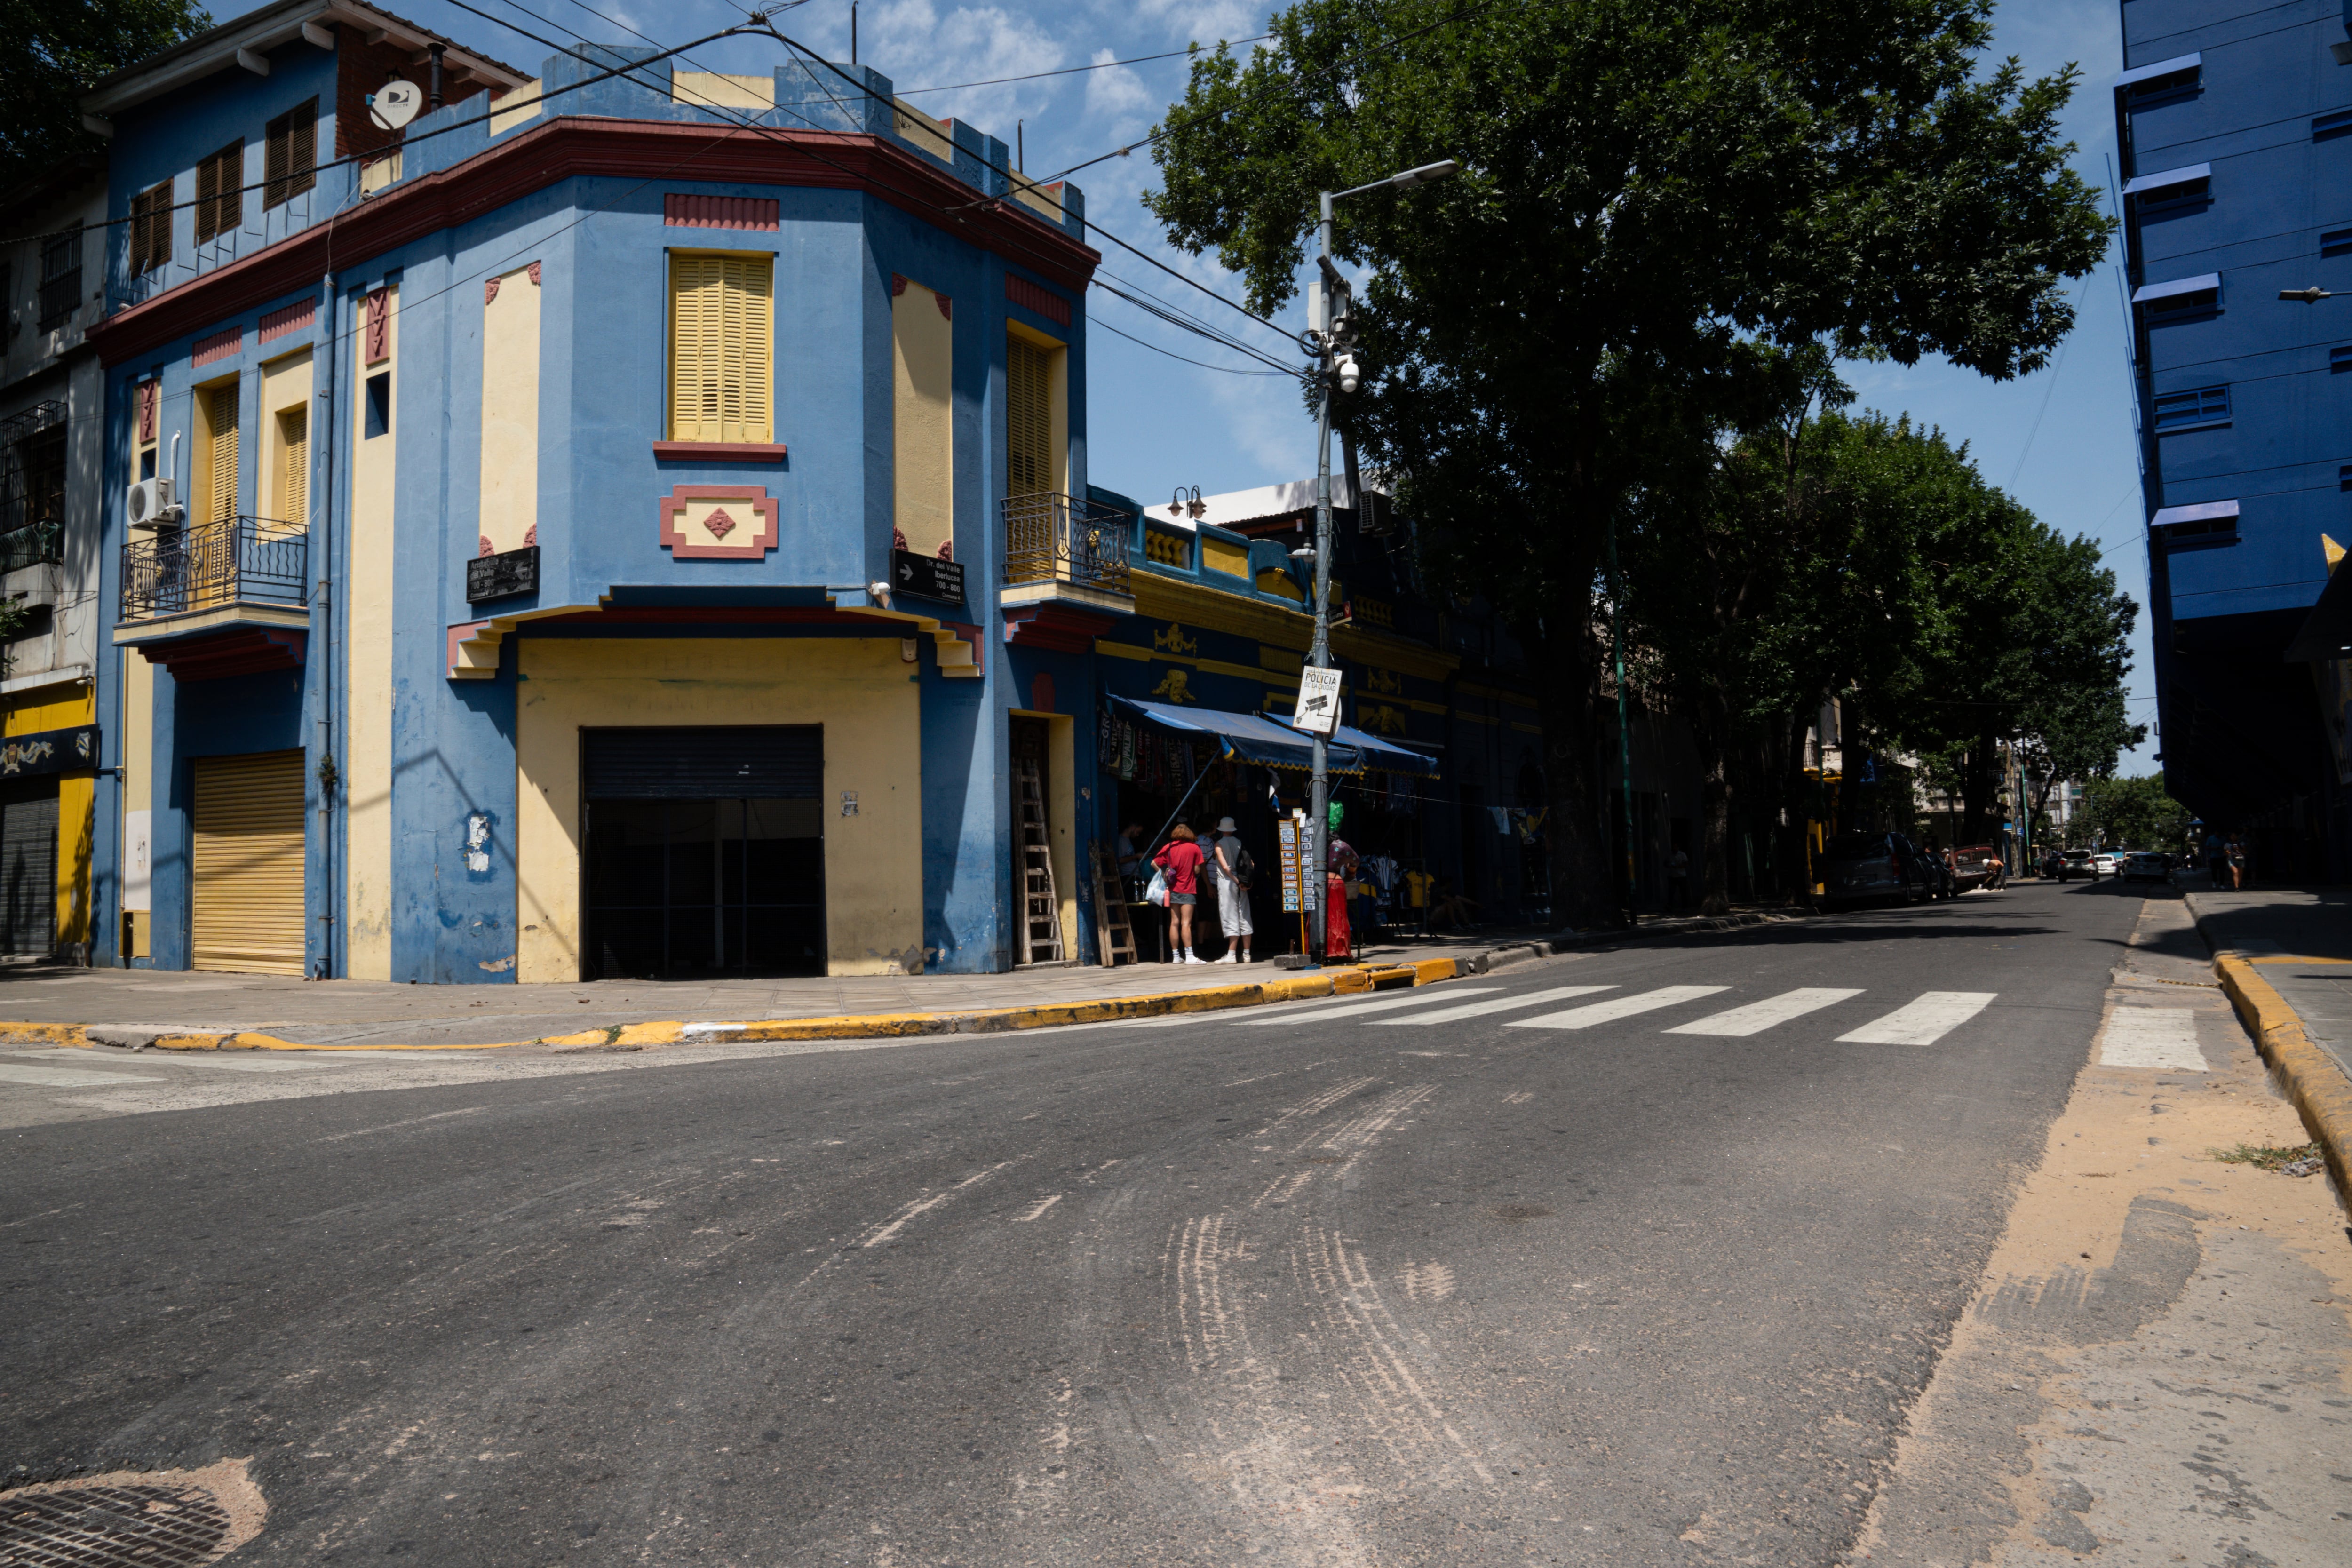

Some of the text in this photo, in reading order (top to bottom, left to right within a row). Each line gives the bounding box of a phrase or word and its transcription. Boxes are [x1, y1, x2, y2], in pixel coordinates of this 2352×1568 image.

[926, 559, 960, 573] Dr. del Valle
[935, 570, 960, 582] Iberlucea
[935, 581, 946, 589] 700
[950, 584, 960, 592] 800
[1305, 673, 1336, 685] POLICIA
